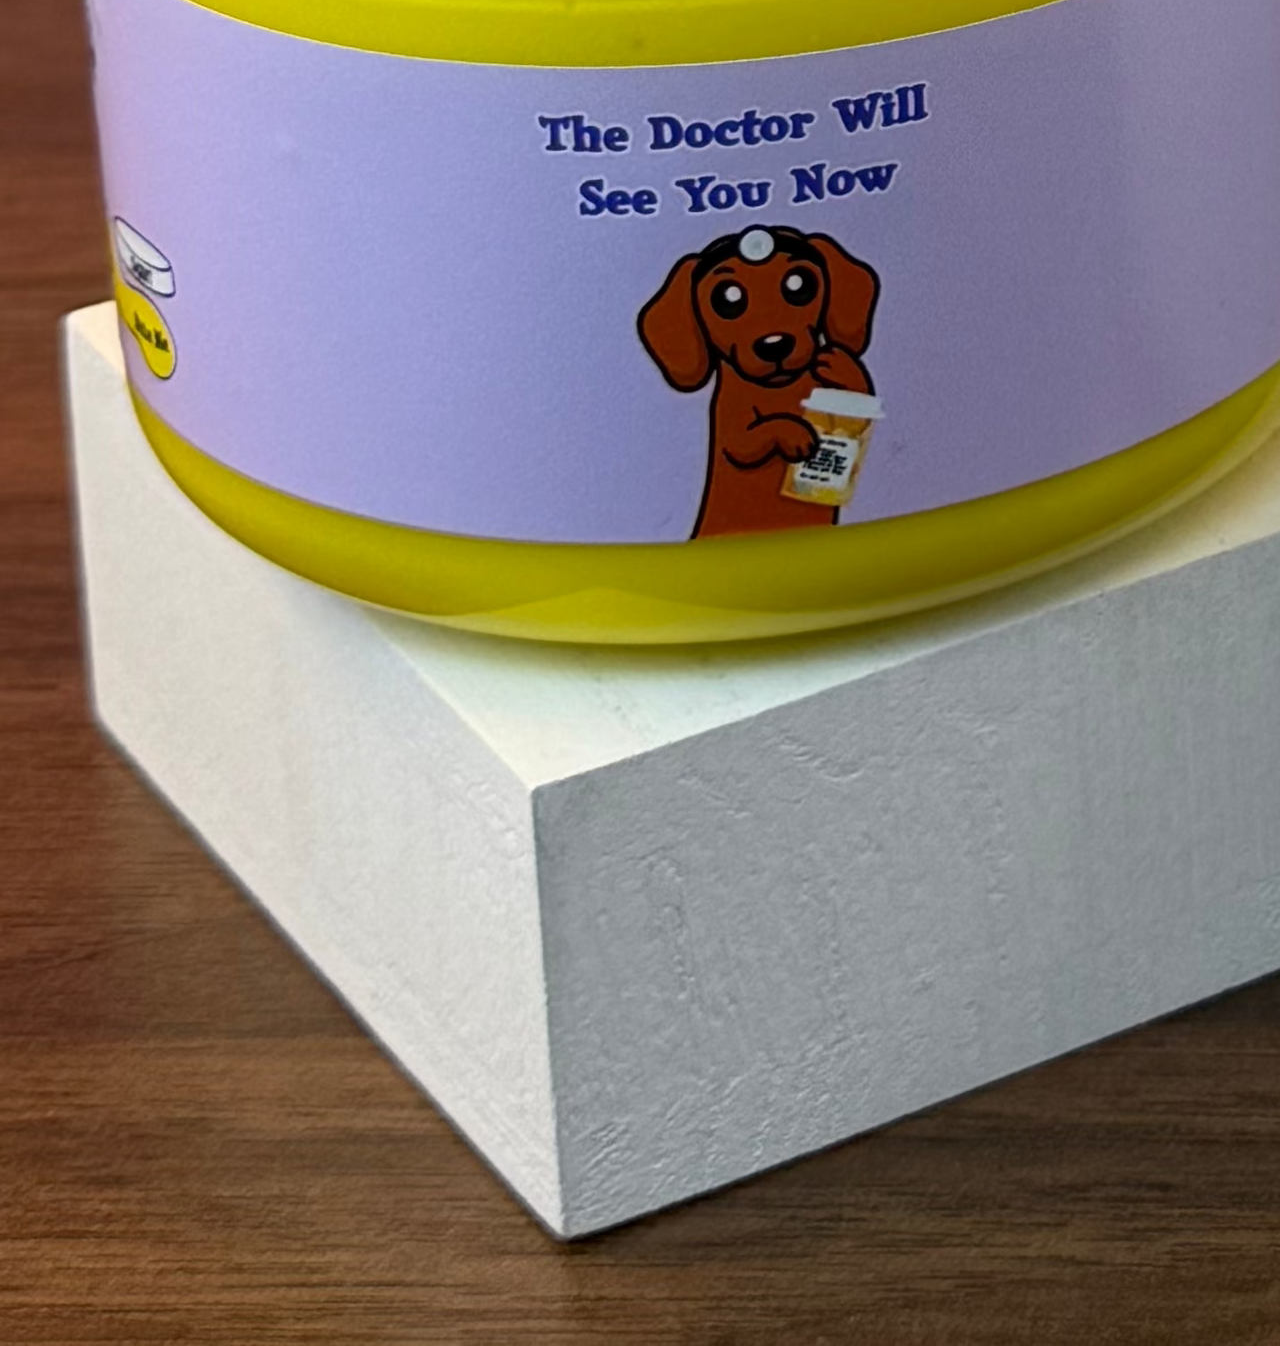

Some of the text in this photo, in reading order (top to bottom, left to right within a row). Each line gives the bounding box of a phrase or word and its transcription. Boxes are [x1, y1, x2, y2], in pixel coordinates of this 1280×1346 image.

[537, 82, 931, 154] The Doctor Will
[578, 162, 900, 218] See You Now
